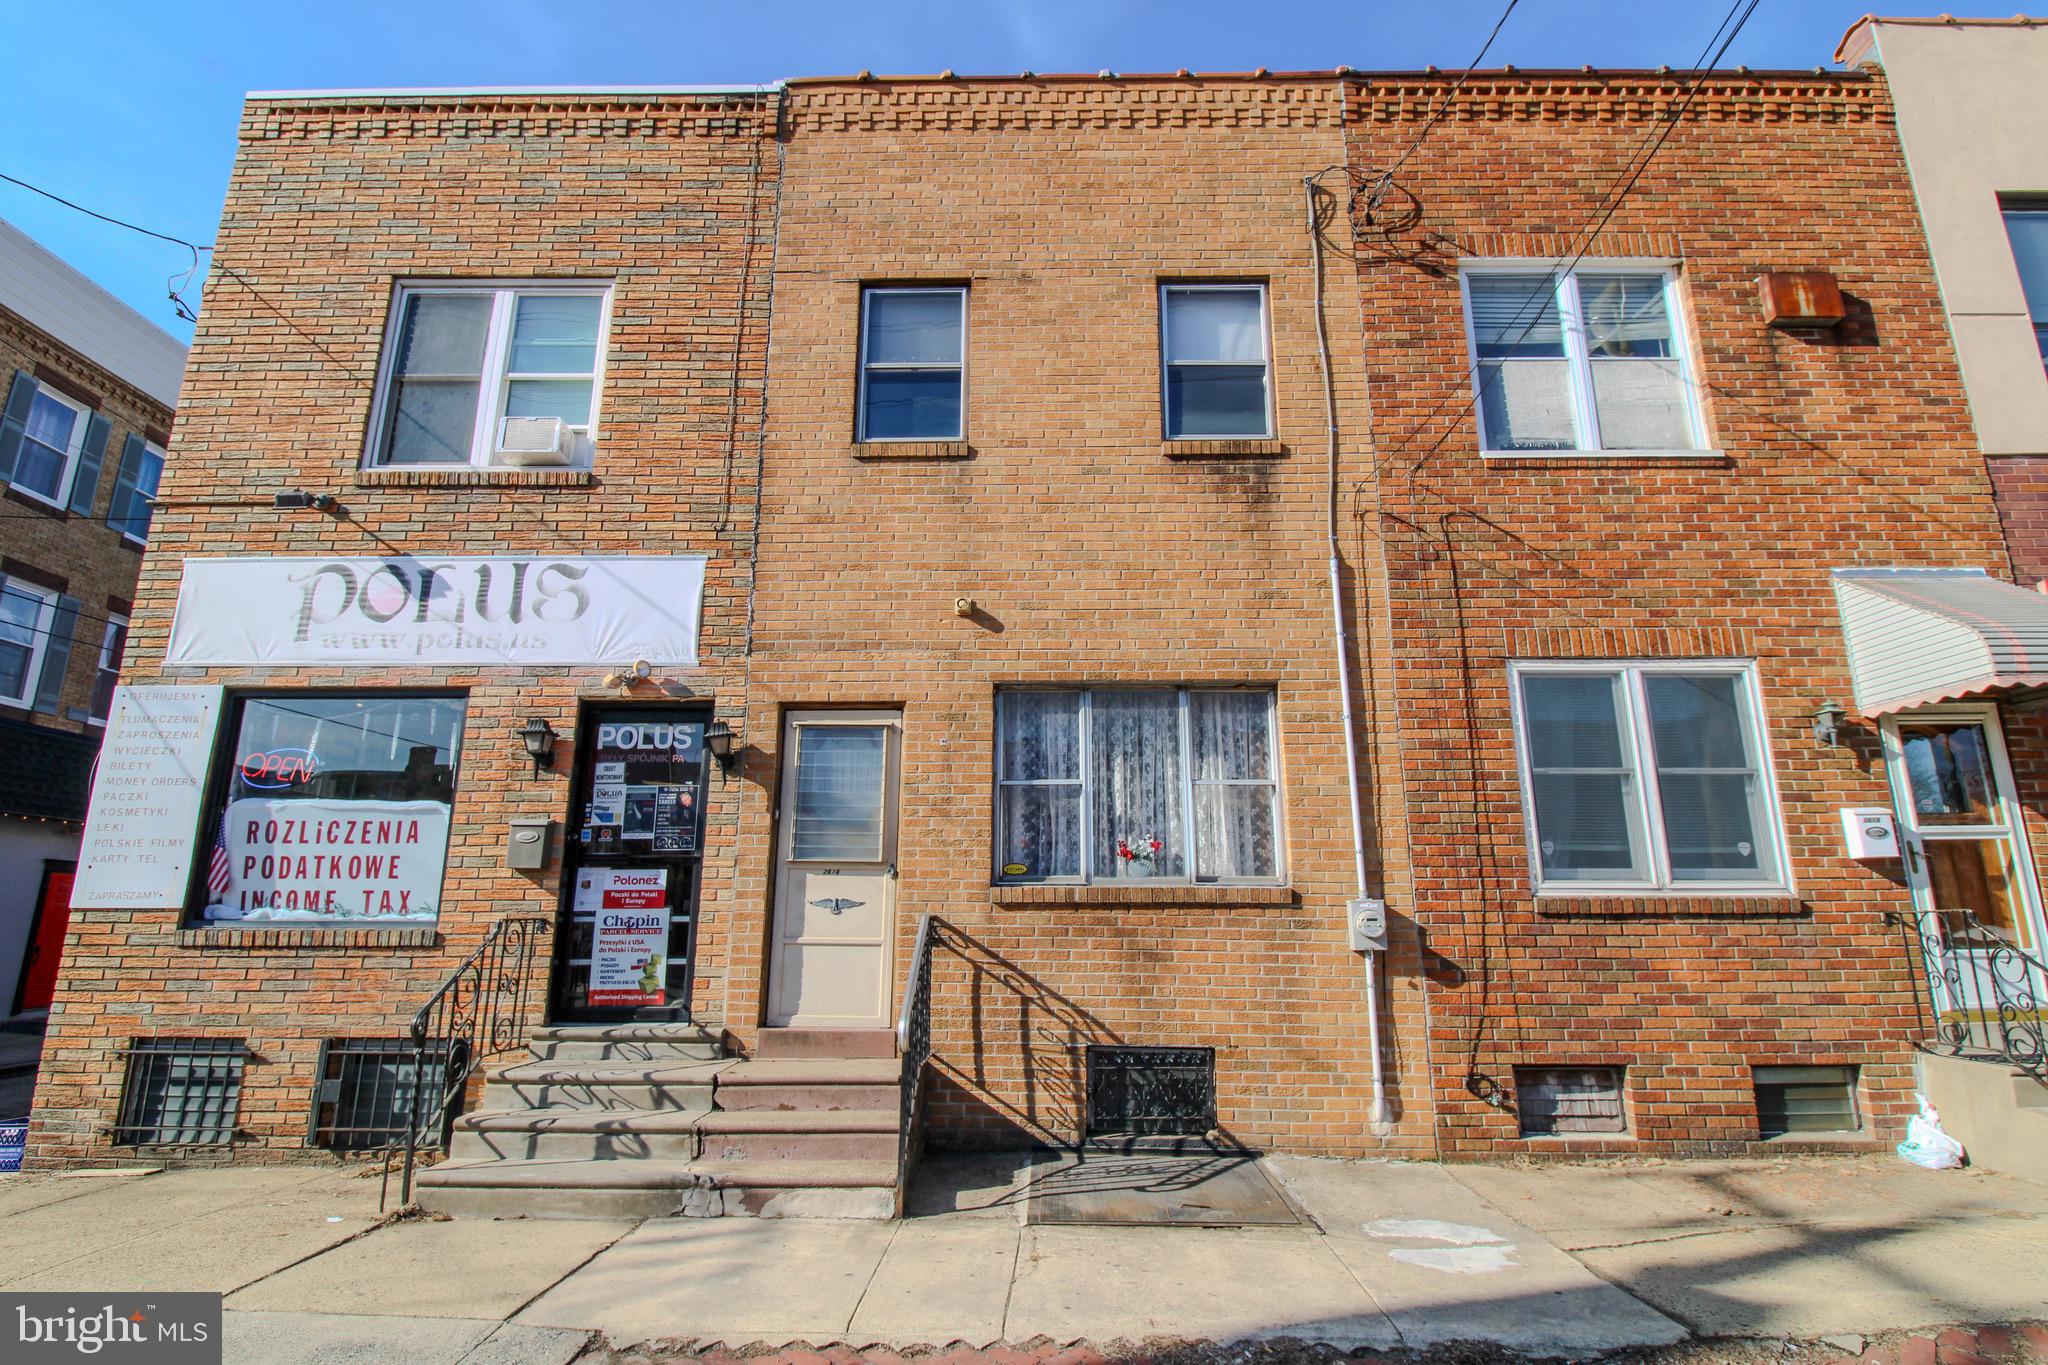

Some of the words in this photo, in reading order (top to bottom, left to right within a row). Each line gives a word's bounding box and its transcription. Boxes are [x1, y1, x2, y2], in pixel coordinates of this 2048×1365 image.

[130, 692, 199, 701] OFERUJEMY
[118, 731, 200, 740] ZAPROSZENIA
[597, 725, 692, 750] POLUS
[114, 746, 182, 755] WYCIECZKI
[672, 754, 685, 763] PA
[110, 762, 152, 771] BILETY
[242, 752, 316, 784] OPEN
[106, 777, 148, 786] MONEY
[151, 777, 197, 786] ORDERS
[103, 792, 149, 801] PACZKI
[100, 808, 169, 817] KOSMETYKI
[96, 823, 126, 832] LEKI
[94, 839, 145, 848] POLSKIE
[151, 839, 185, 848] FILMY
[90, 854, 130, 863] KARTY
[243, 855, 401, 880] PODATKOWE
[613, 875, 659, 886] Polonez
[88, 891, 160, 901] ZAPRASZAMY
[240, 890, 337, 914] INCOME
[362, 889, 412, 914] TAX
[603, 914, 660, 929] Chopin
[631, 946, 652, 954] Europy
